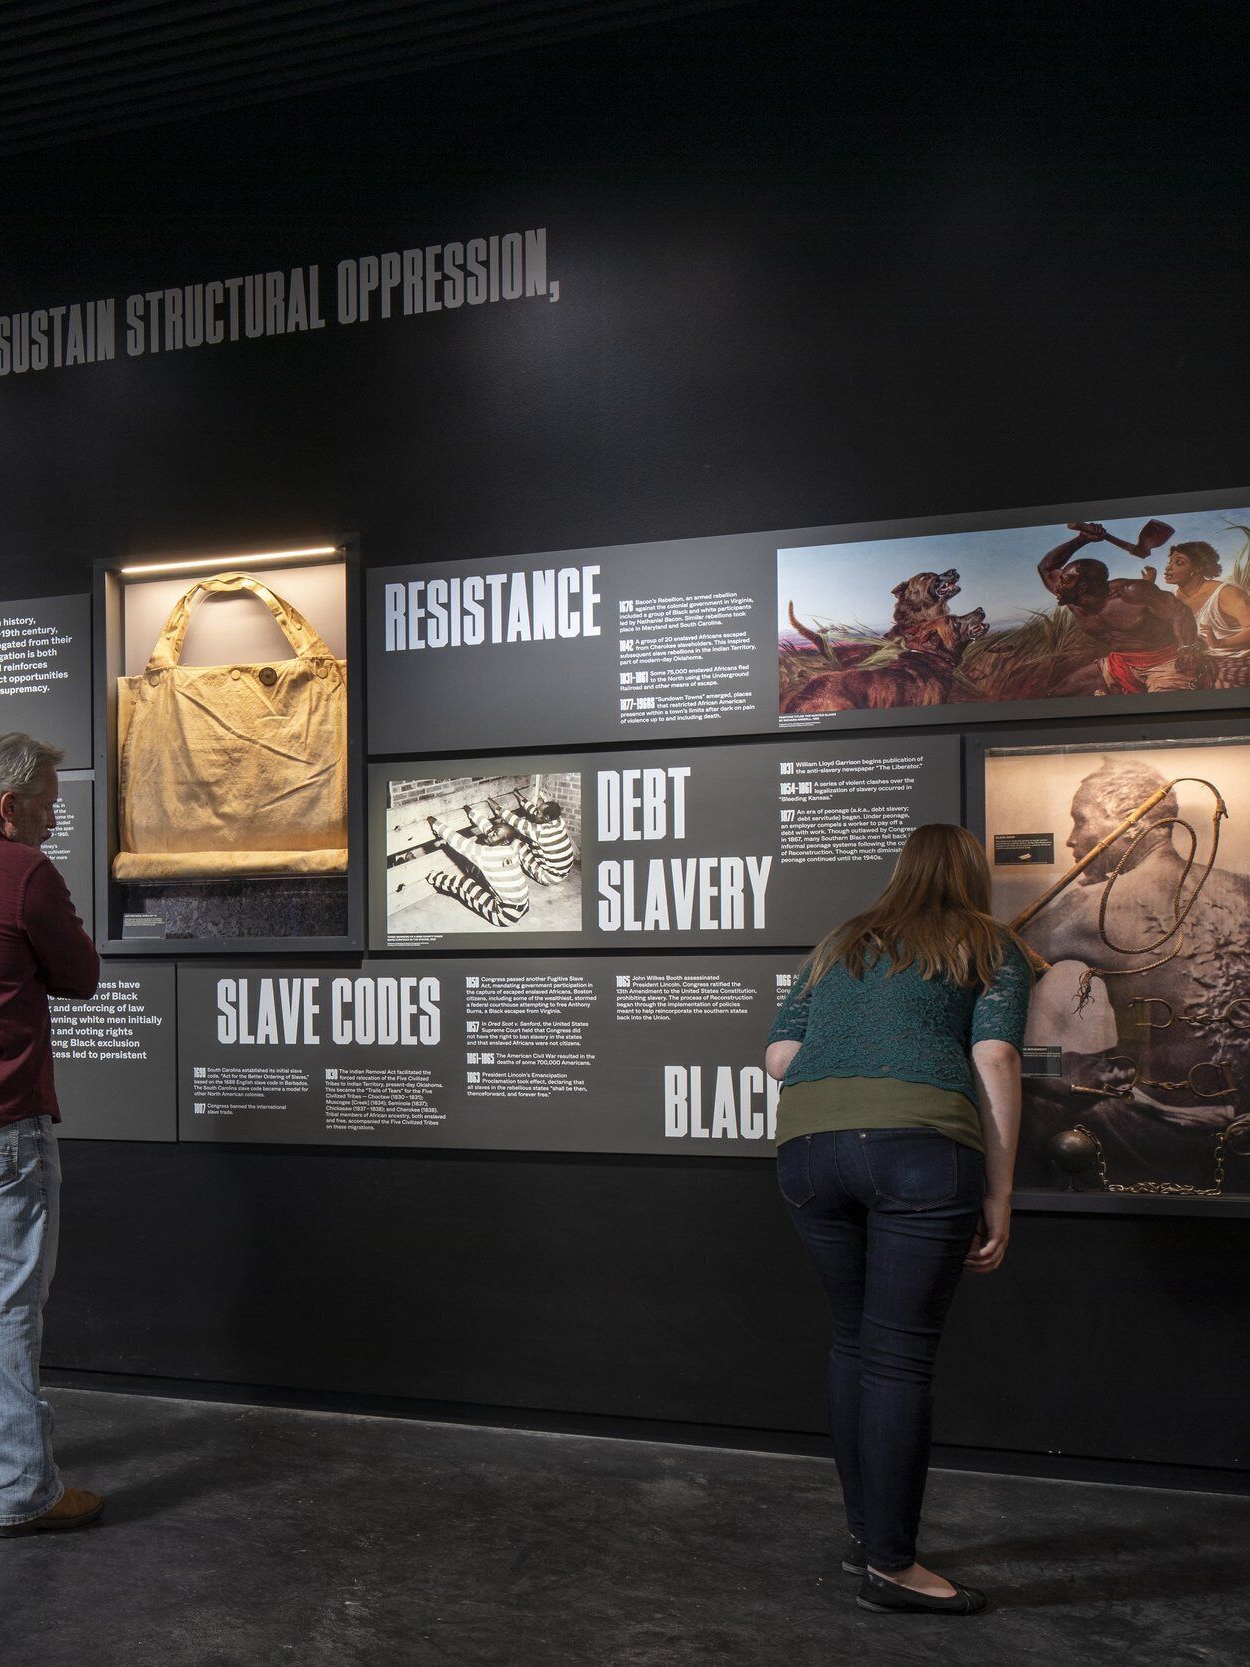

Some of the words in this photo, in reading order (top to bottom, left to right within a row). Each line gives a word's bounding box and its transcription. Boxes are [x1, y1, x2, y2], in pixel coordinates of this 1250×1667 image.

[126, 264, 326, 357] STRUCTURAL
[337, 228, 560, 325] OPPRESSION,
[385, 565, 601, 652] RESISTANCE
[4, 618, 36, 627] history,
[22, 628, 58, 636] century,
[51, 636, 72, 645] their
[37, 649, 57, 658] both
[4, 663, 48, 672] reinforces
[9, 671, 68, 684] opportunities
[0, 686, 50, 696] supremacy.
[883, 756, 916, 764] publication
[598, 766, 691, 842] DEBT
[598, 855, 773, 932] SLAVERY
[72, 1004, 115, 1014] enforcing
[217, 978, 320, 1045] SLAVE
[332, 977, 441, 1045] CODES
[128, 1016, 162, 1026] initially
[75, 1027, 104, 1037] voting
[106, 1027, 133, 1037] rights
[100, 1051, 147, 1060] persistent
